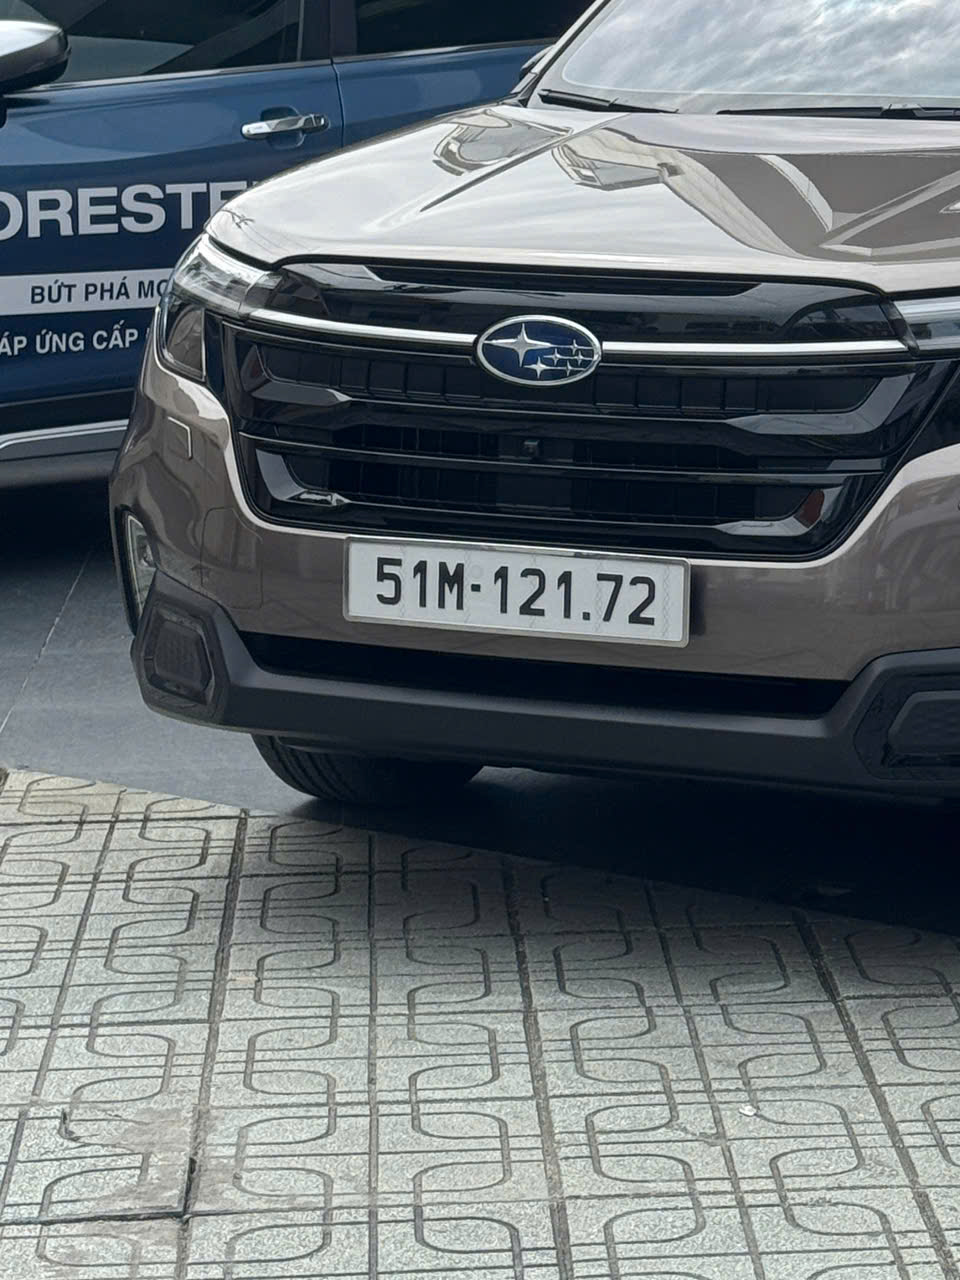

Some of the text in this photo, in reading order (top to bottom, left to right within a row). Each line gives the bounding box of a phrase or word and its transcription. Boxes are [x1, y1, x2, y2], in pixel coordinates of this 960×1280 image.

[30, 279, 77, 304] BỨT
[84, 276, 130, 302] PHÁ
[35, 329, 85, 354] ỨNG
[92, 320, 139, 350] CẤP
[376, 556, 656, 626] 51M-121.72
